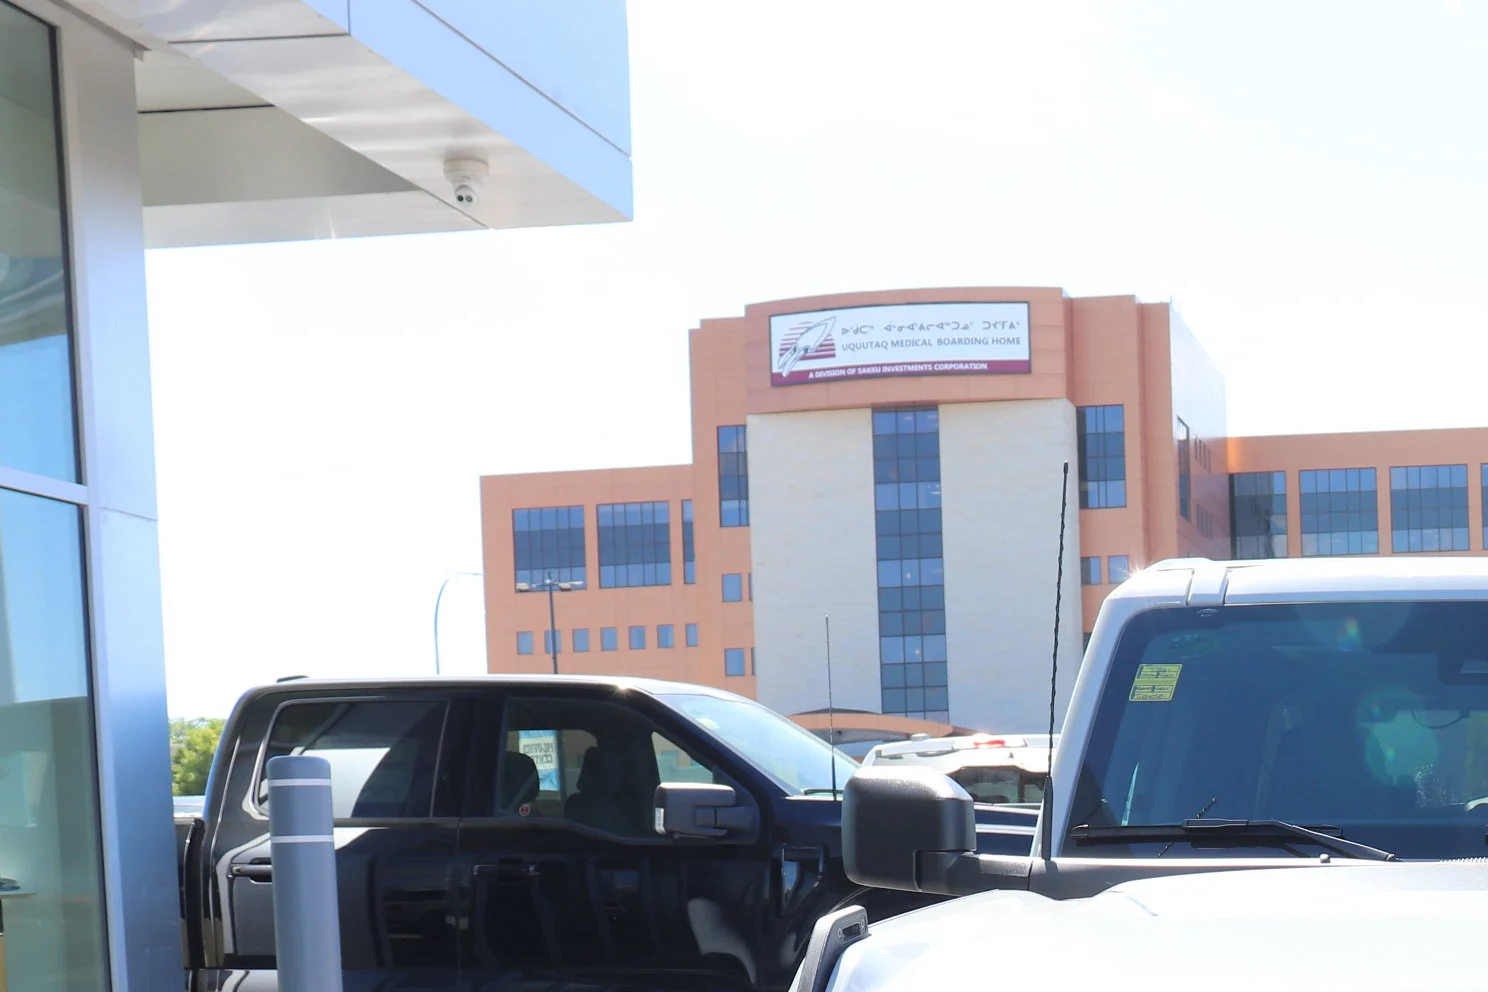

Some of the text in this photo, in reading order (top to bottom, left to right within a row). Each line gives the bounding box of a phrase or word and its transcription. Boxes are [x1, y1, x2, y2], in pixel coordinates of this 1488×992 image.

[841, 336, 1021, 351] UQUUTAQ MEDICAL BOARDING HOME
[815, 369, 846, 378] DIVISION
[846, 367, 857, 376] OF
[882, 363, 933, 373] INVESTMENTS
[933, 362, 988, 371] CORPORATION
